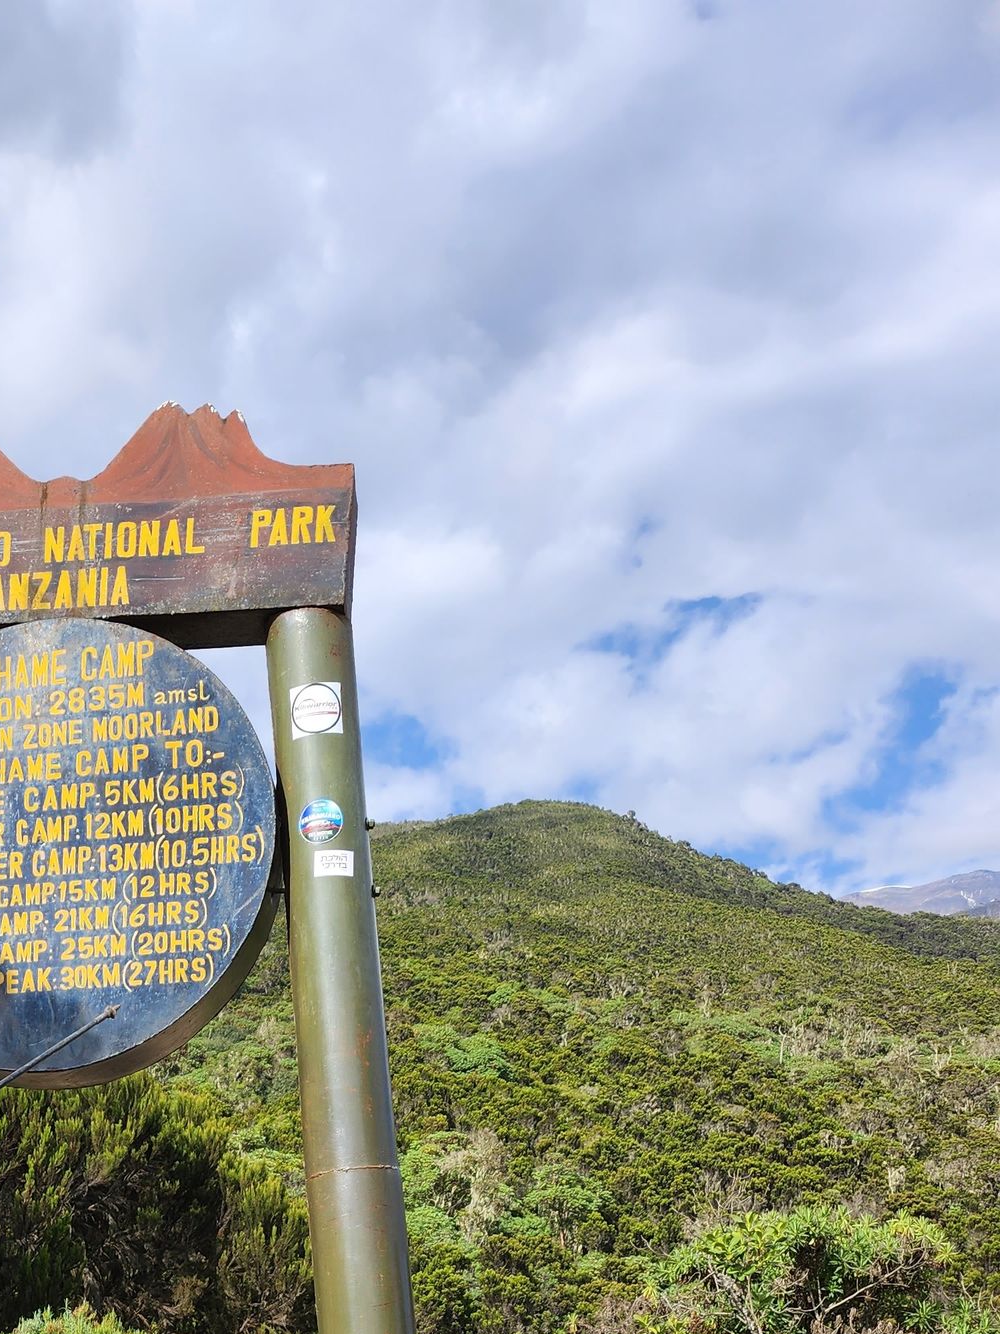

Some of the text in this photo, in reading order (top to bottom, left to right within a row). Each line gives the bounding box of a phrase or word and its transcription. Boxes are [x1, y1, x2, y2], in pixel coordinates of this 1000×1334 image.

[44, 517, 205, 563] NATIONAL
[250, 505, 336, 548] PARK
[80, 640, 154, 682] CAMP
[50, 682, 144, 715] 2835M
[154, 680, 210, 705] amsl
[23, 720, 82, 750] ZONE
[93, 706, 218, 742] MOORLAND
[76, 744, 149, 777] CAMP
